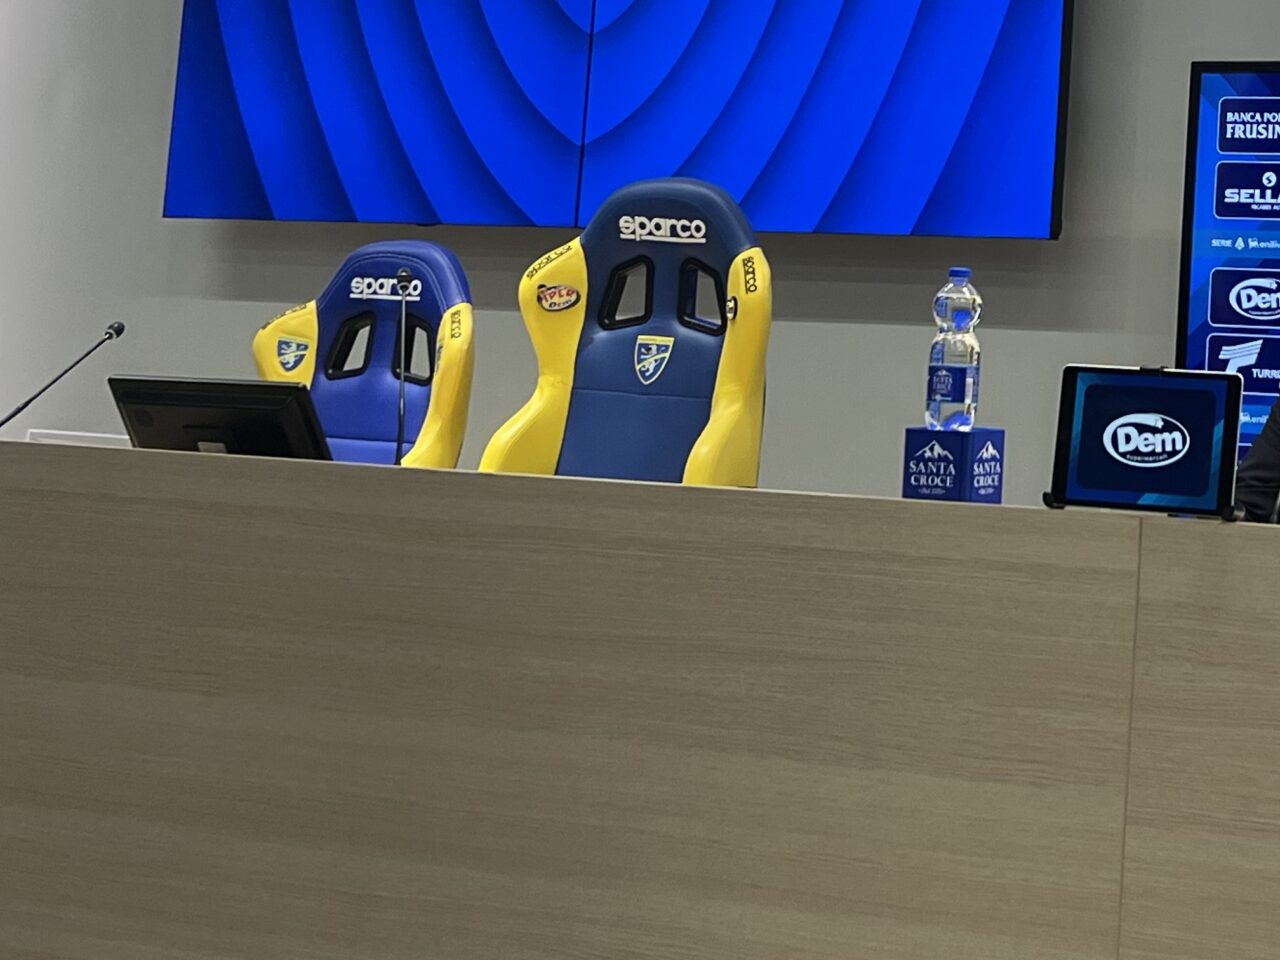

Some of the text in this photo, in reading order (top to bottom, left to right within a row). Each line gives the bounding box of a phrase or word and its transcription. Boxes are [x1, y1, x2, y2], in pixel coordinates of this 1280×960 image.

[1226, 112, 1262, 122] BANCA
[619, 215, 706, 241] sparco
[743, 256, 757, 294] sparco
[1117, 425, 1183, 453] Dem
[909, 460, 955, 475] SANTA
[973, 462, 1001, 475] SANTA
[910, 474, 954, 487] CROCE
[974, 475, 999, 488] CROCE
